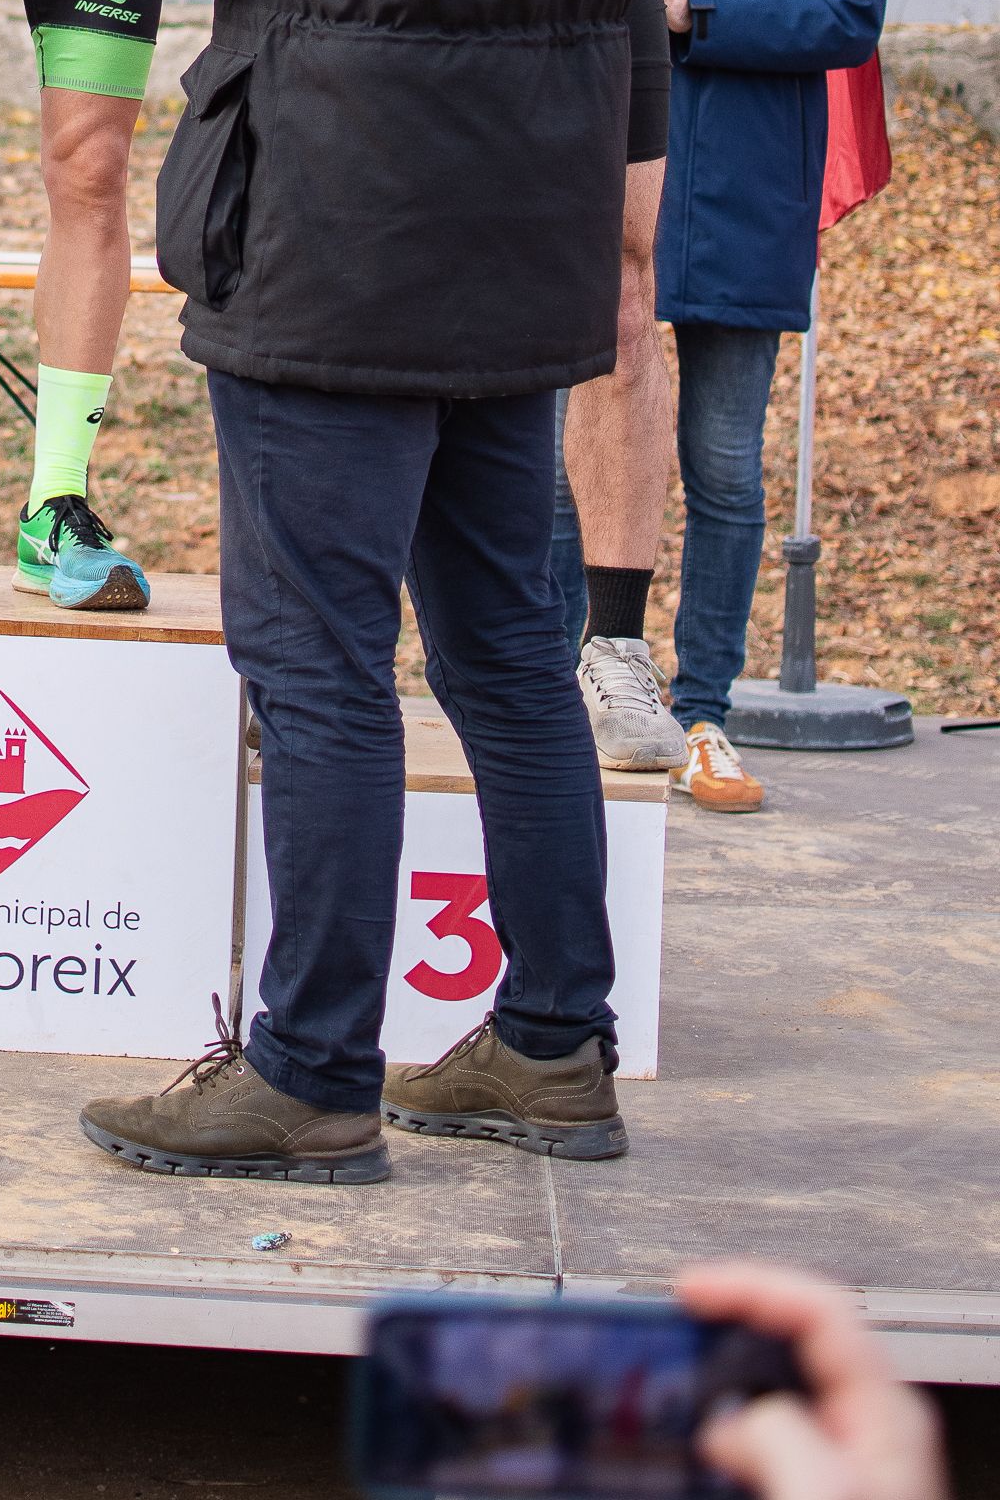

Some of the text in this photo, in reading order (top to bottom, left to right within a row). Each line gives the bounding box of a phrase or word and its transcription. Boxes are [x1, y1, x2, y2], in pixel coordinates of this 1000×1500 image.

[74, 0, 141, 24] INVERSE
[103, 901, 141, 931] de
[404, 871, 502, 1001] 3
